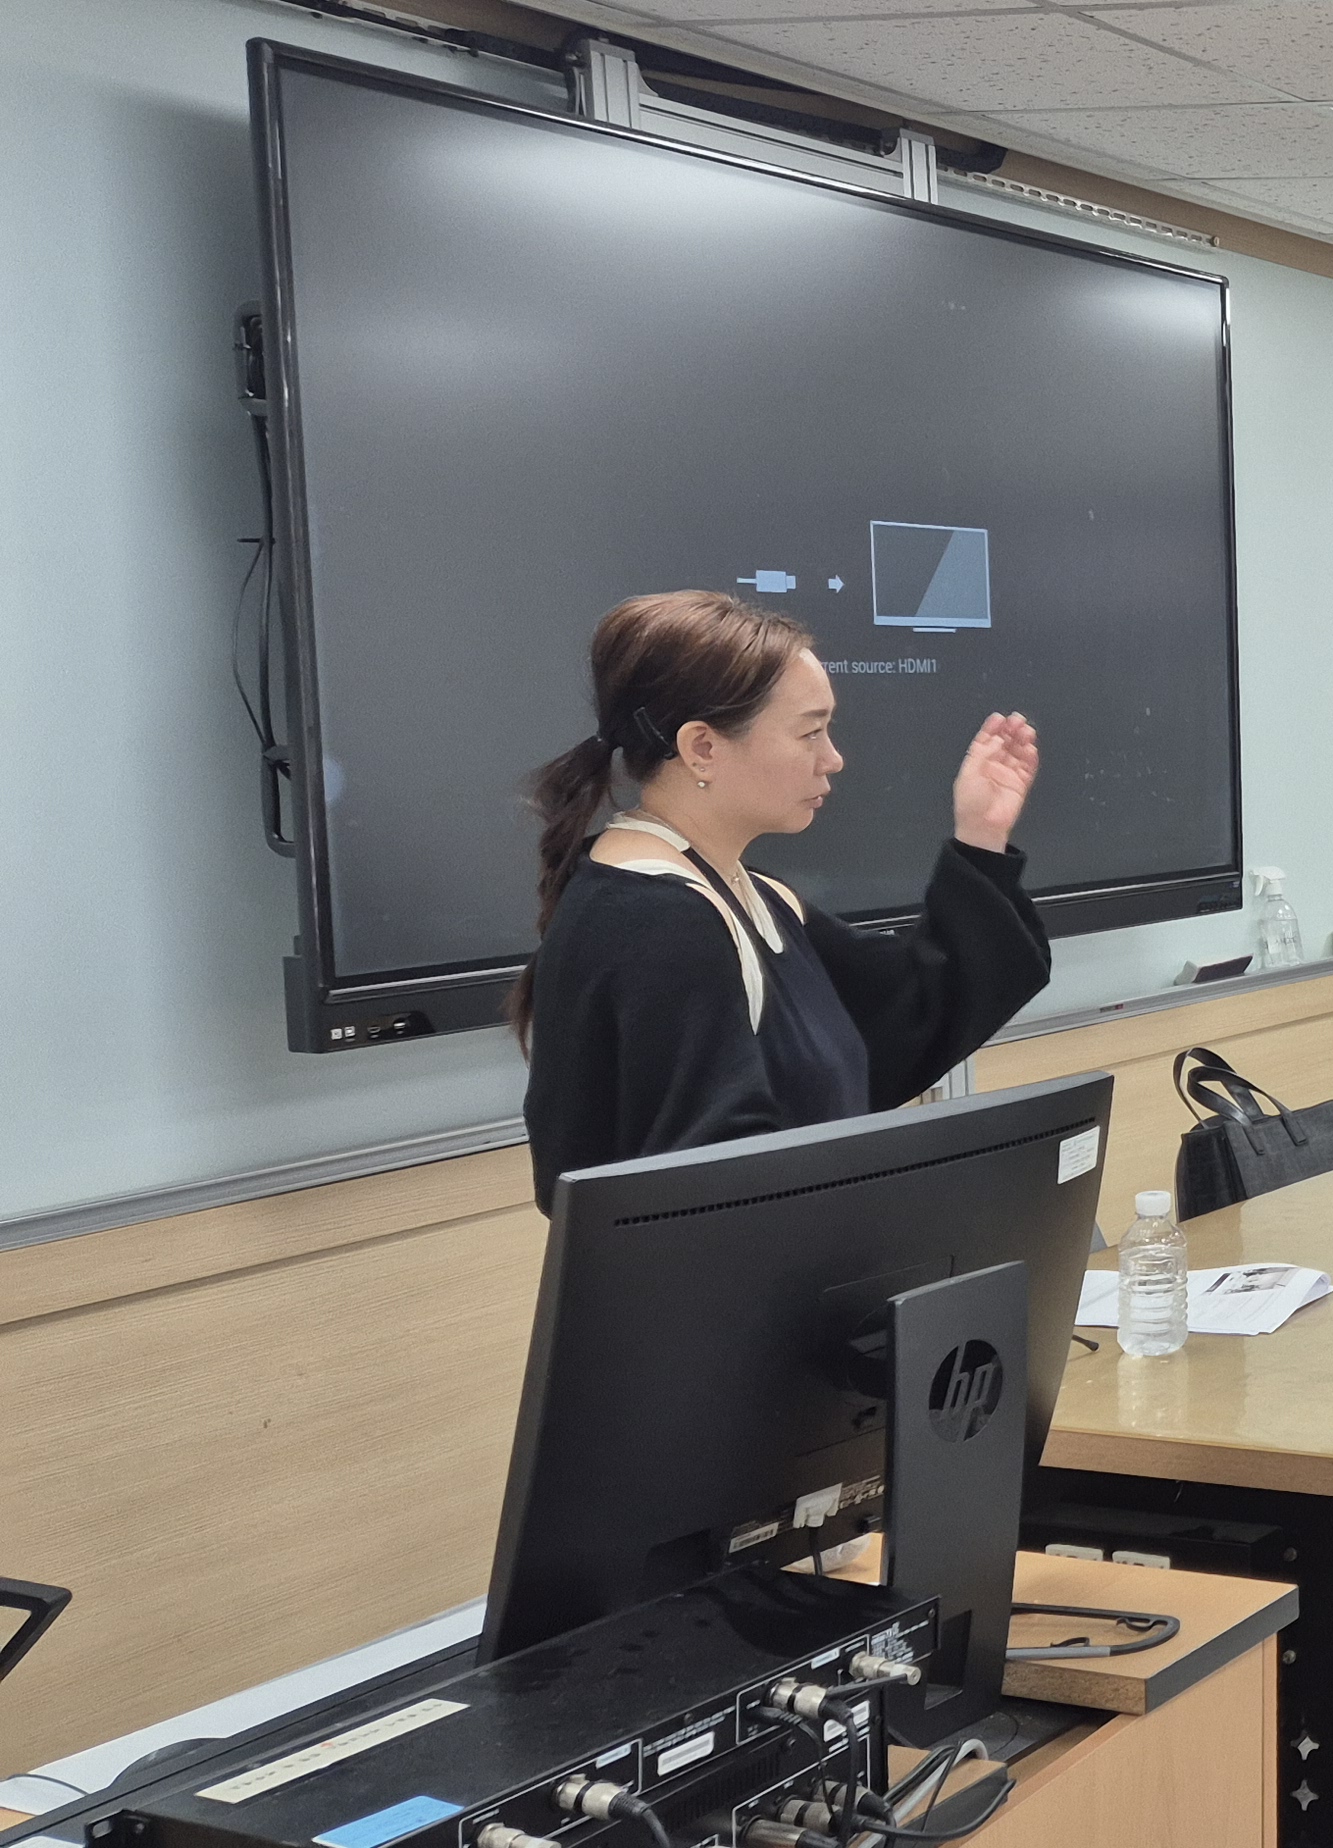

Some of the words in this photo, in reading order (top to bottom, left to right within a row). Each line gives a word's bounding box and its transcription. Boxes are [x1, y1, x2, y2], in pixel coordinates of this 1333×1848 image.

[851, 661, 896, 674] source:
[898, 658, 937, 674] HDMI1
[936, 1340, 999, 1442] hp
